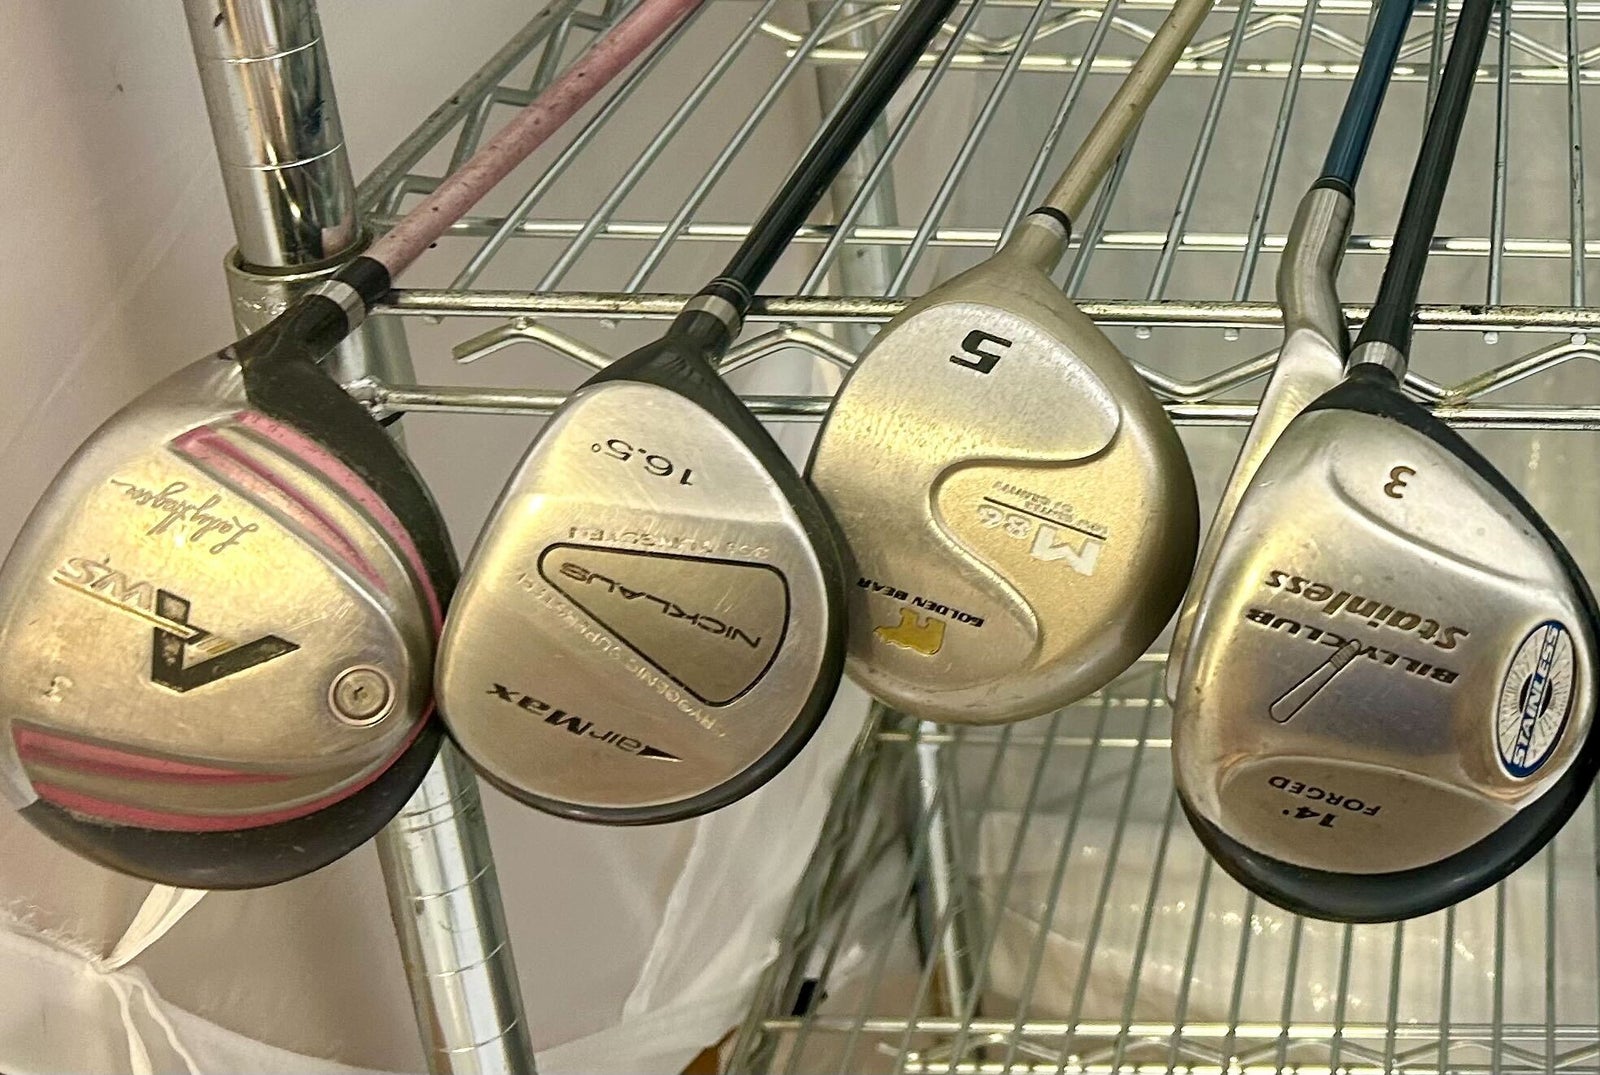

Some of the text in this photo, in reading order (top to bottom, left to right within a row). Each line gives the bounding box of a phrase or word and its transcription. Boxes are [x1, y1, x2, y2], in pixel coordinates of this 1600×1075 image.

[949, 329, 1012, 374] 5
[591, 438, 695, 487] 16.5°
[1383, 465, 1417, 499] 3
[189, 494, 259, 554] Lady
[560, 561, 761, 649] NICKLAUS
[857, 577, 985, 627] GOLDEN BEAR
[1264, 569, 1470, 650] Stainless
[1511, 622, 1563, 769] STAINLESS
[1269, 775, 1382, 817] FORGED
